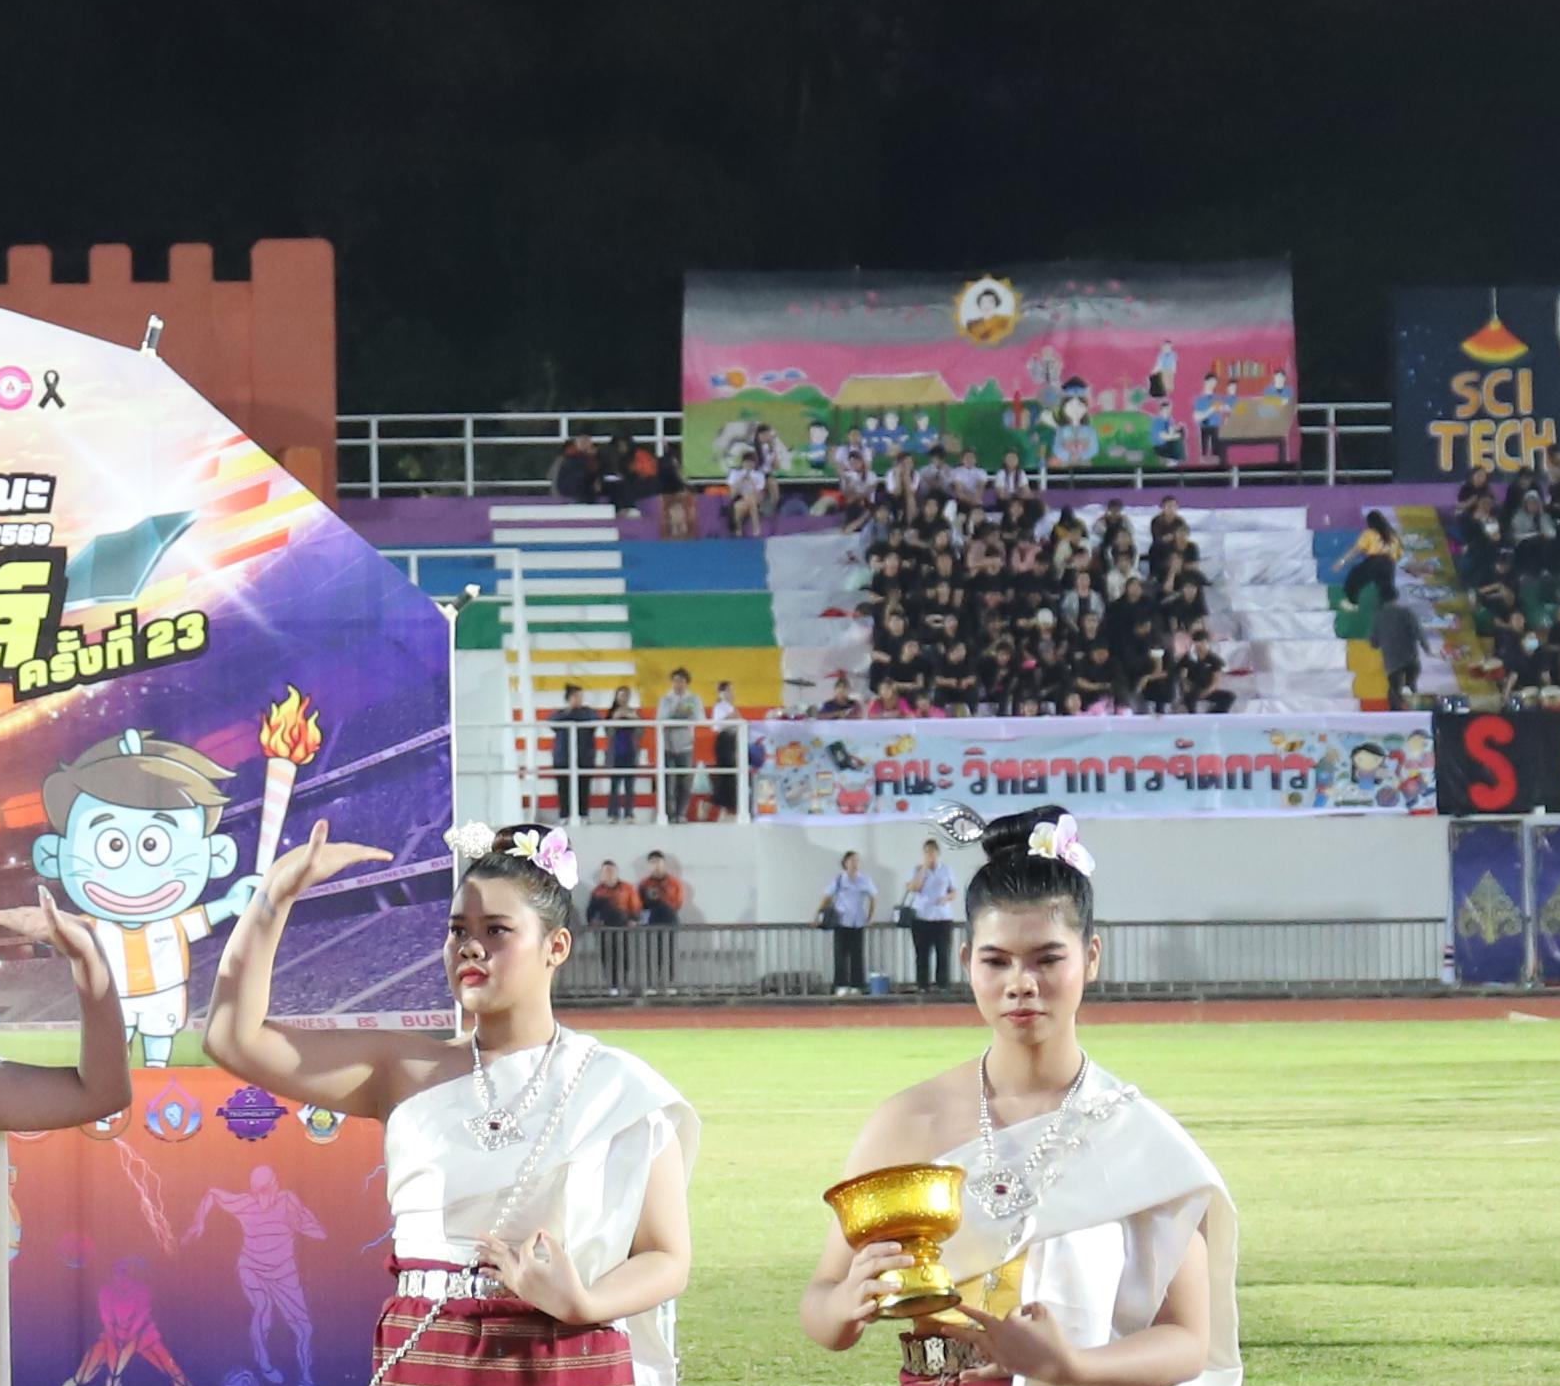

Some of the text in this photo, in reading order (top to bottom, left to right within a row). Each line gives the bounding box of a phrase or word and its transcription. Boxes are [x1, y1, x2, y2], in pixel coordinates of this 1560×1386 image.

[1451, 368, 1534, 419] SCI
[1427, 417, 1558, 474] TECH
[18, 612, 207, 694] ครั้งที่ 23
